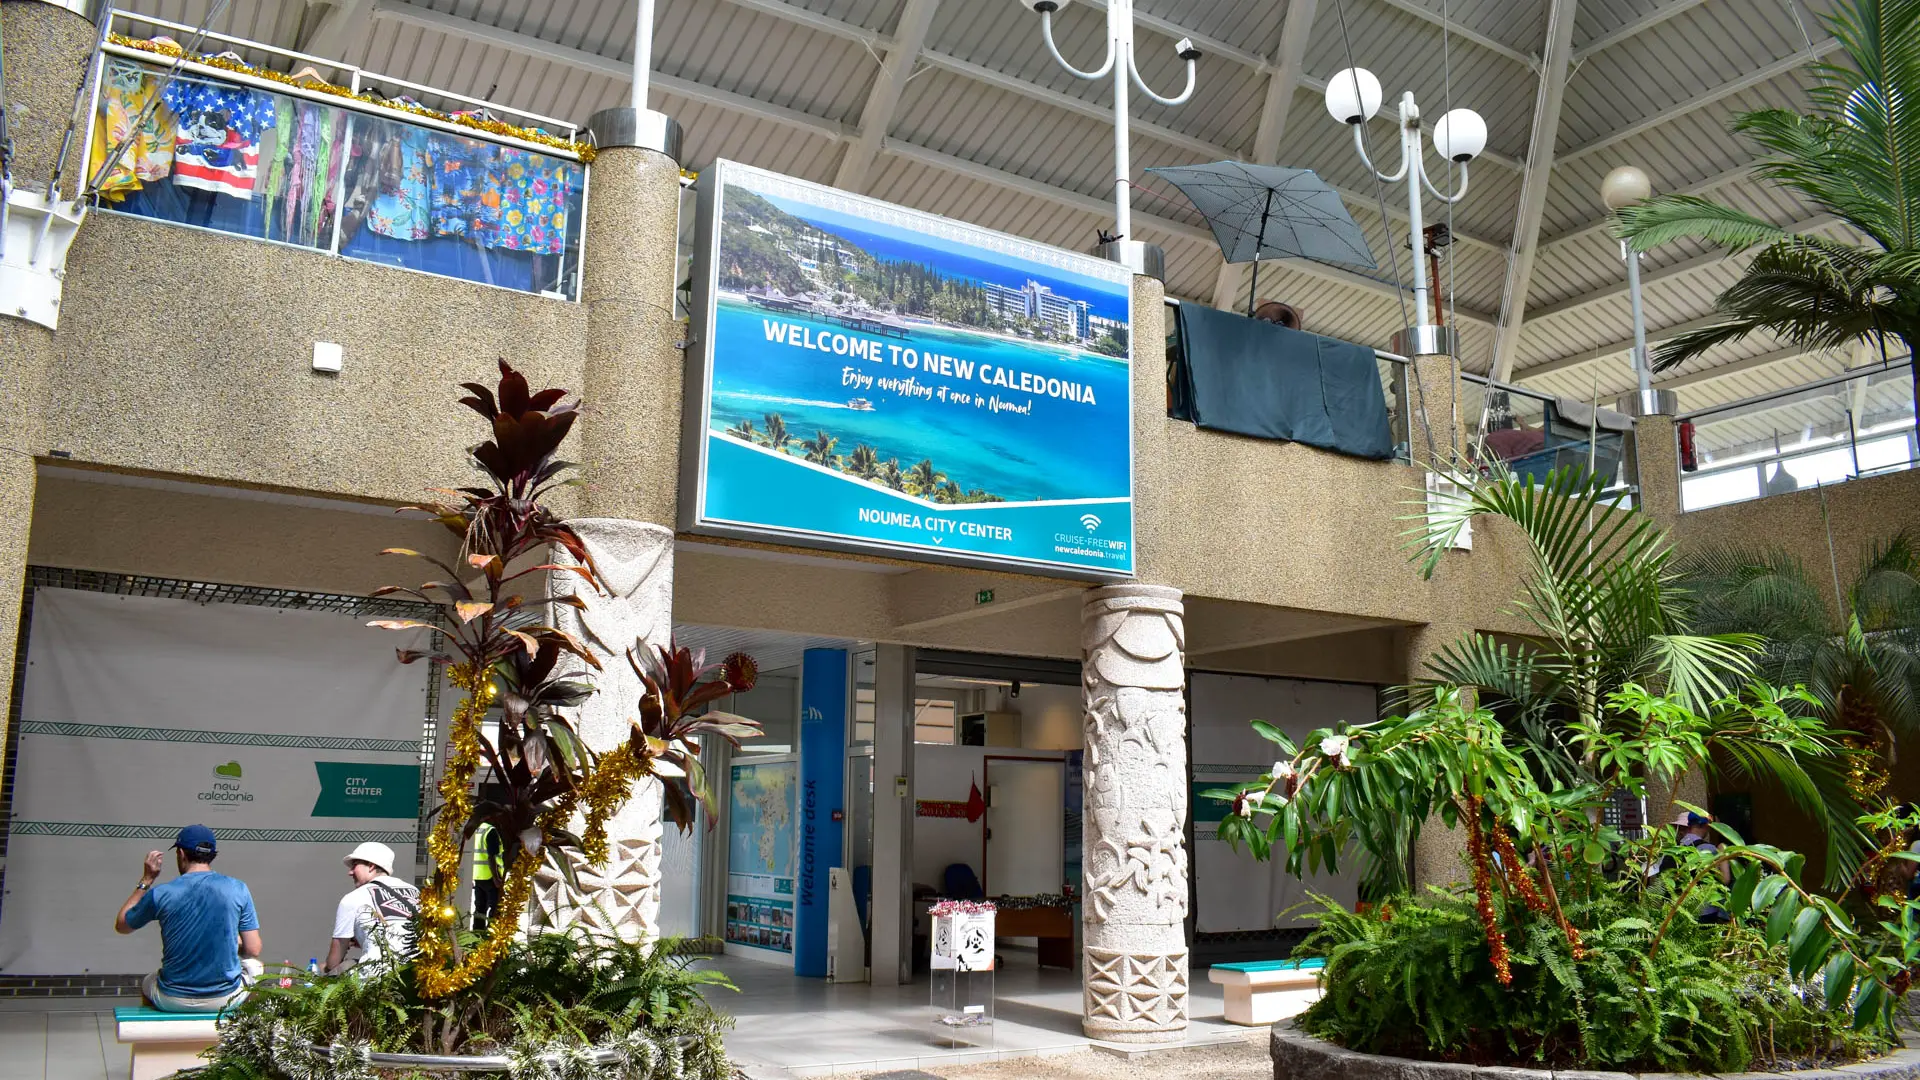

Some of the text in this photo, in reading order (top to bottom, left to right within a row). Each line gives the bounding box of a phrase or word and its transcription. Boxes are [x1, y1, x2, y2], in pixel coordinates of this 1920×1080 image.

[763, 319, 1097, 406] WELCOME TO NEW CALEDONIA
[841, 365, 1032, 416] Enjoy everything at once in Noumea!
[858, 508, 1013, 541] NOUMEA CITY CENTER
[1055, 545, 1126, 561] newcaledonia.travel
[213, 783, 240, 791] new
[345, 777, 368, 786] CITY
[197, 791, 254, 802] caledonia
[345, 787, 383, 796] CENTER
[801, 779, 816, 907] Welcome desk
